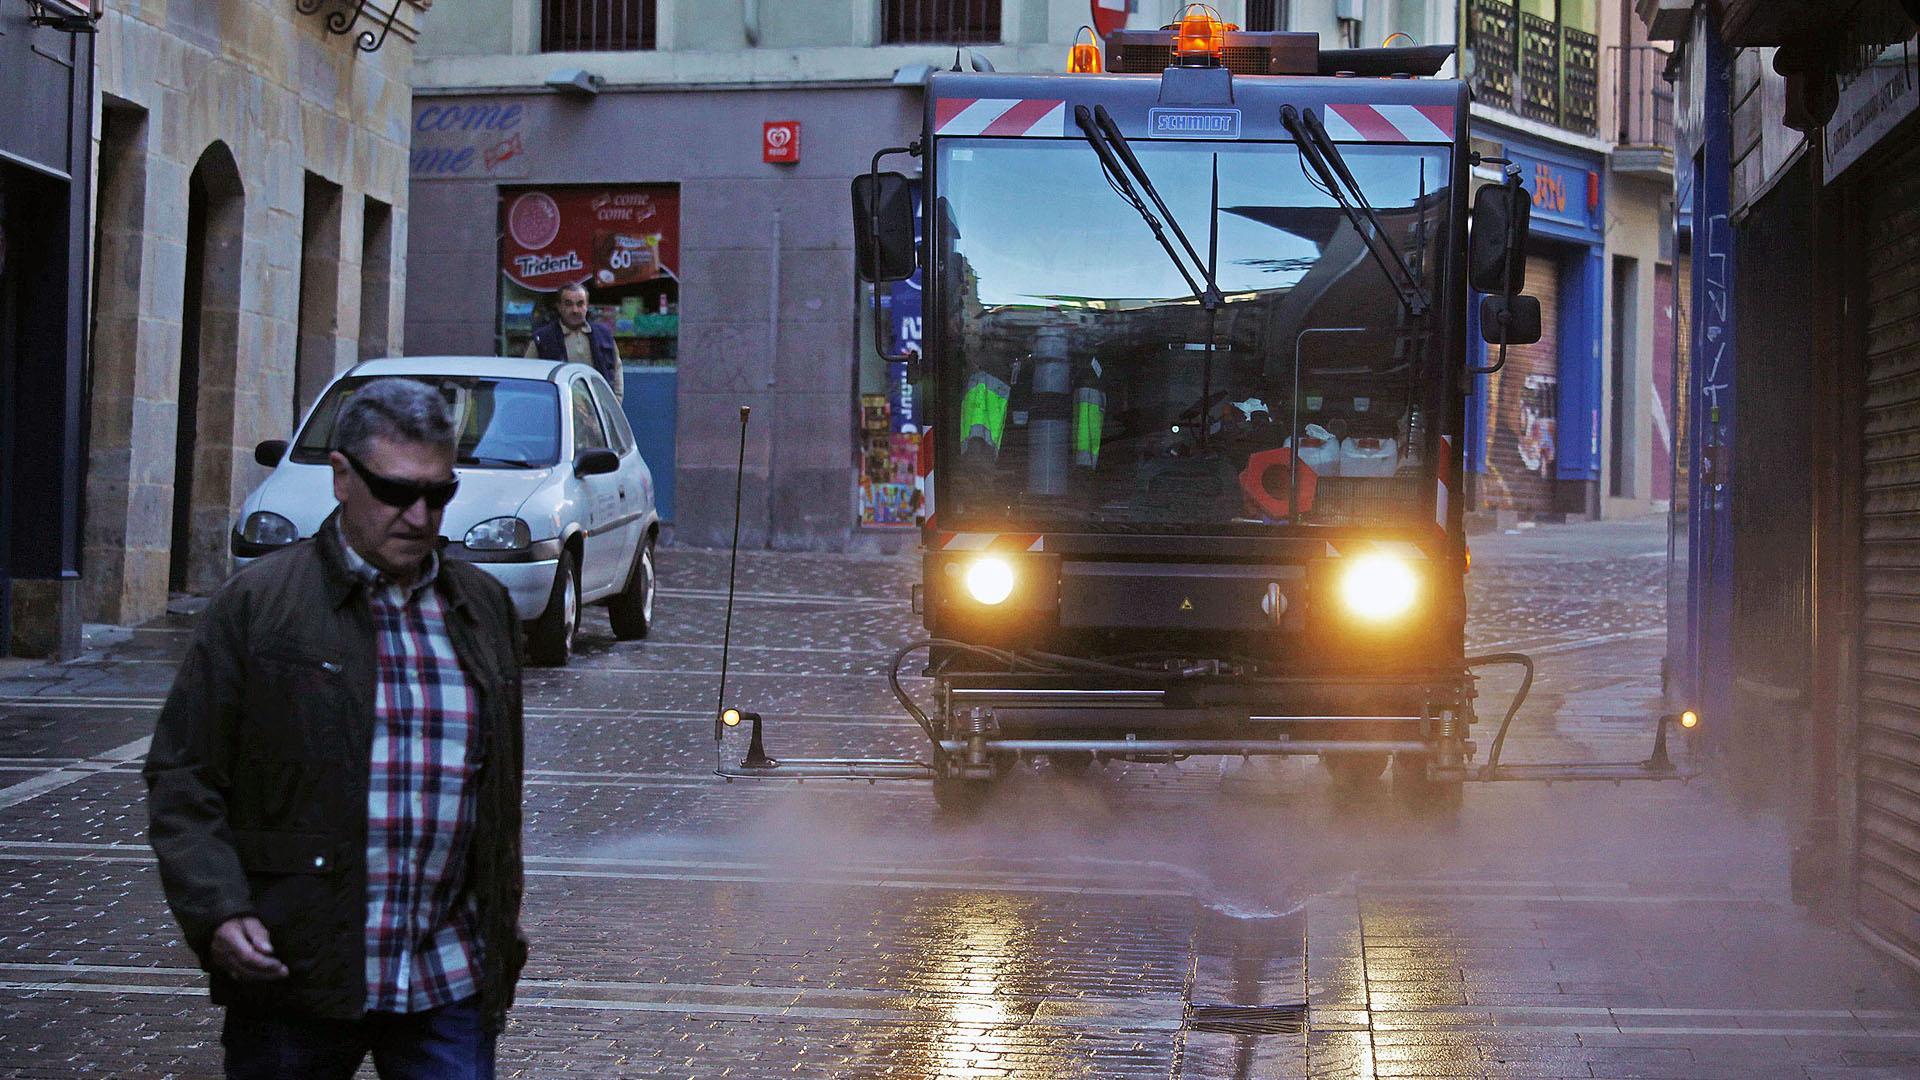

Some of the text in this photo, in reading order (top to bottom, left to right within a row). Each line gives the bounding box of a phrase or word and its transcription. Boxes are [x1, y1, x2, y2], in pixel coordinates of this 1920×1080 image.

[415, 103, 522, 132] come
[1158, 114, 1232, 131] SCHMIDT
[515, 250, 583, 278] Trident
[611, 250, 631, 269] 60
